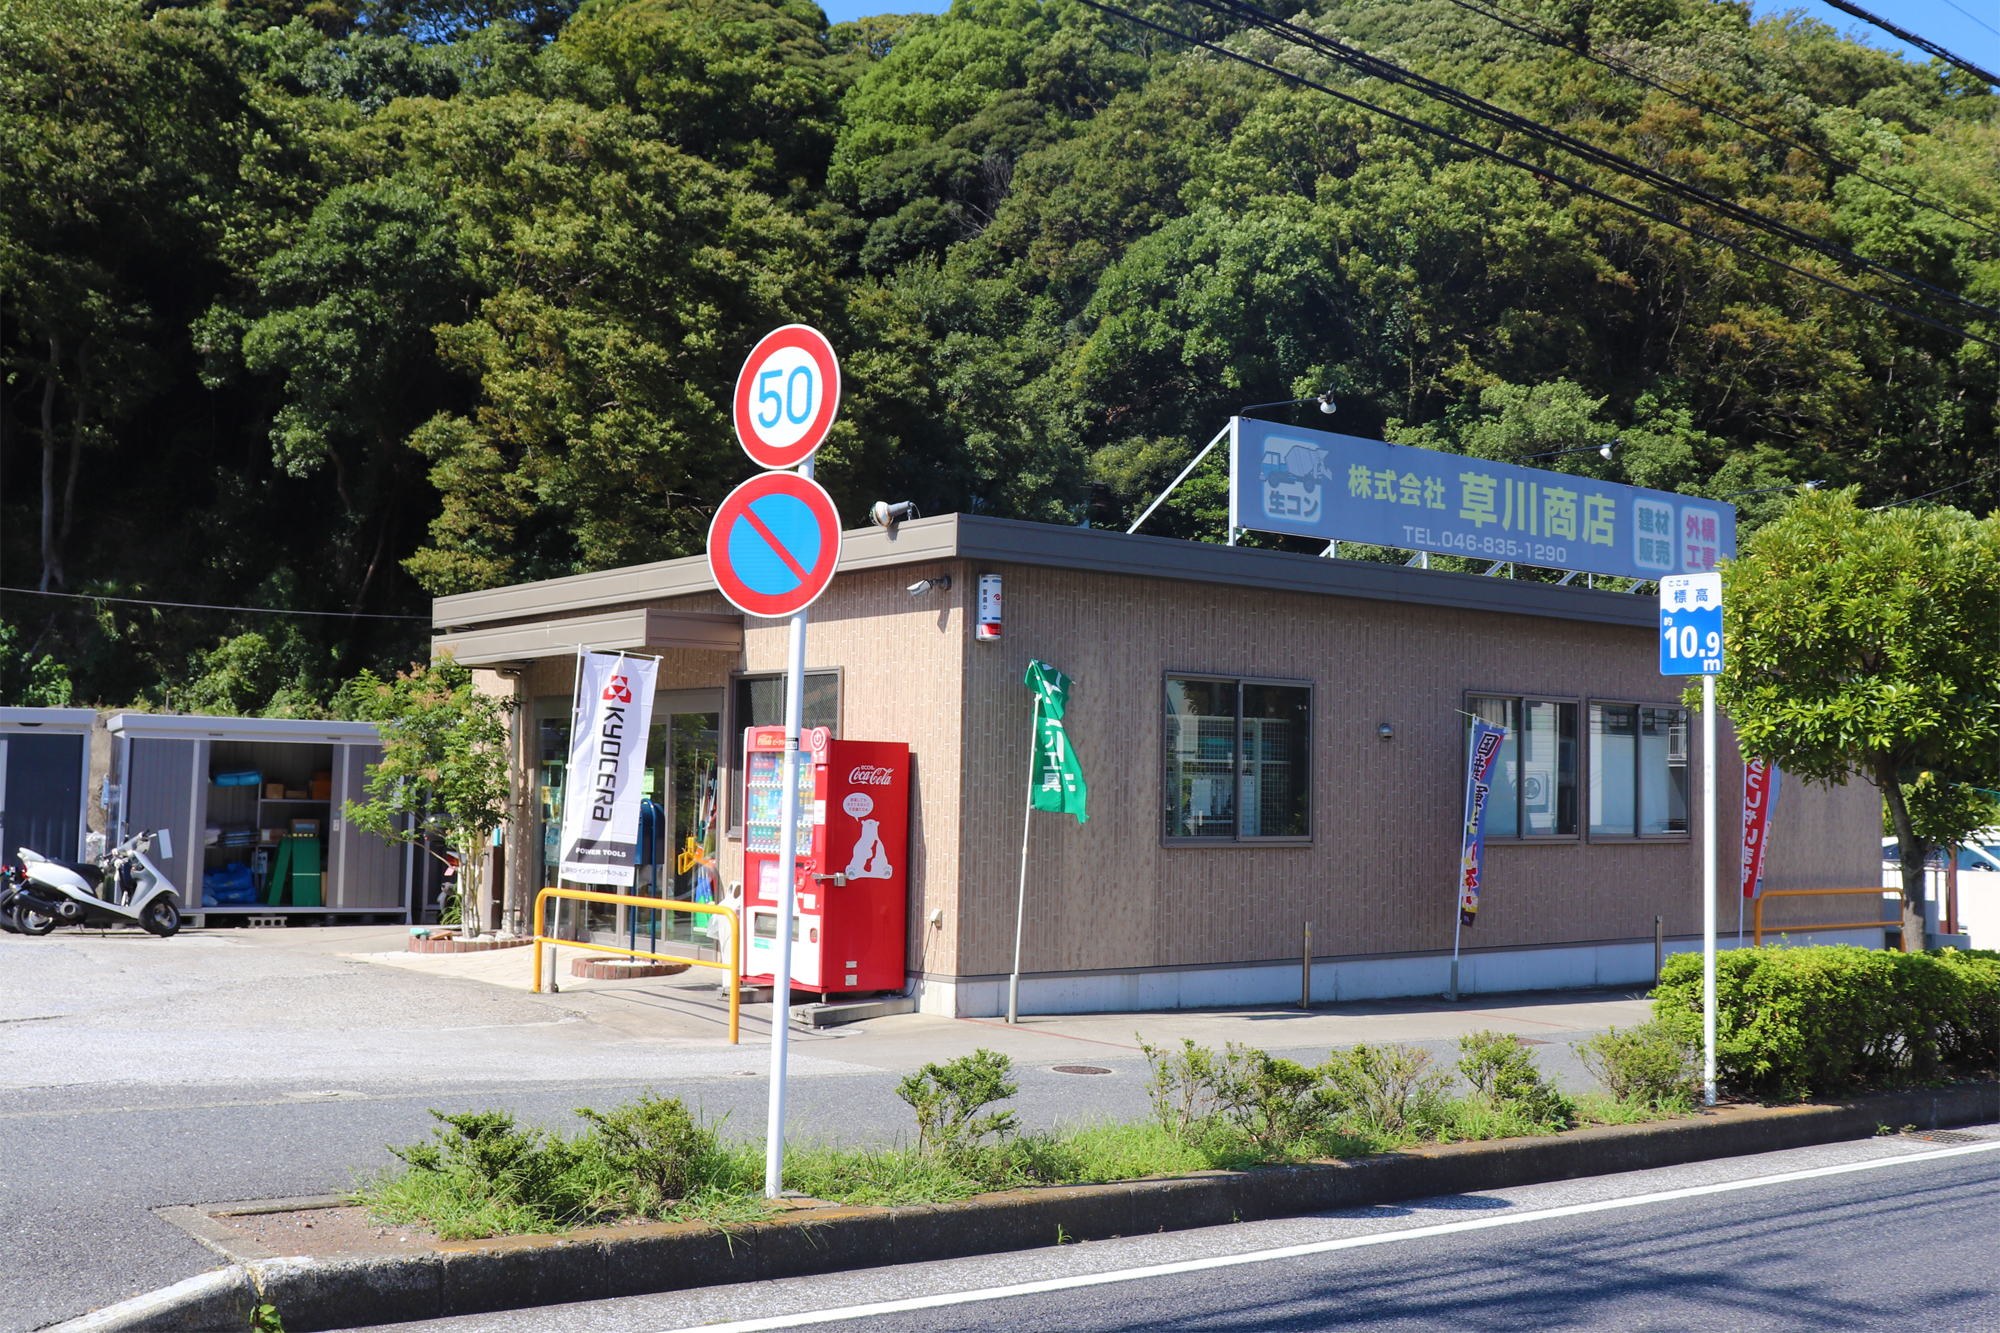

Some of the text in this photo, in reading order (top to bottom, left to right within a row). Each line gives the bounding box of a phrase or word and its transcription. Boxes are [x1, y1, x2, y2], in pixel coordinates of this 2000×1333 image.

[758, 365, 813, 429] 50
[1268, 490, 1319, 517] 生コン
[1348, 463, 1616, 547] 株式会社 草川商店
[1638, 506, 1670, 535] 建材
[1685, 514, 1716, 542] 外構
[1402, 525, 1567, 563] TEL.046-835-1290
[1638, 537, 1670, 565] 販売
[1686, 544, 1716, 571] 工事
[1668, 579, 1690, 587] ここは
[1674, 588, 1708, 604] 標高
[1663, 616, 1673, 626] 約
[1664, 625, 1720, 659] 10.9
[1703, 658, 1721, 671] m
[592, 706, 625, 822] KYOCERA
[848, 766, 895, 786] Coca-Cola
[575, 847, 627, 858] POWER TOOLS
